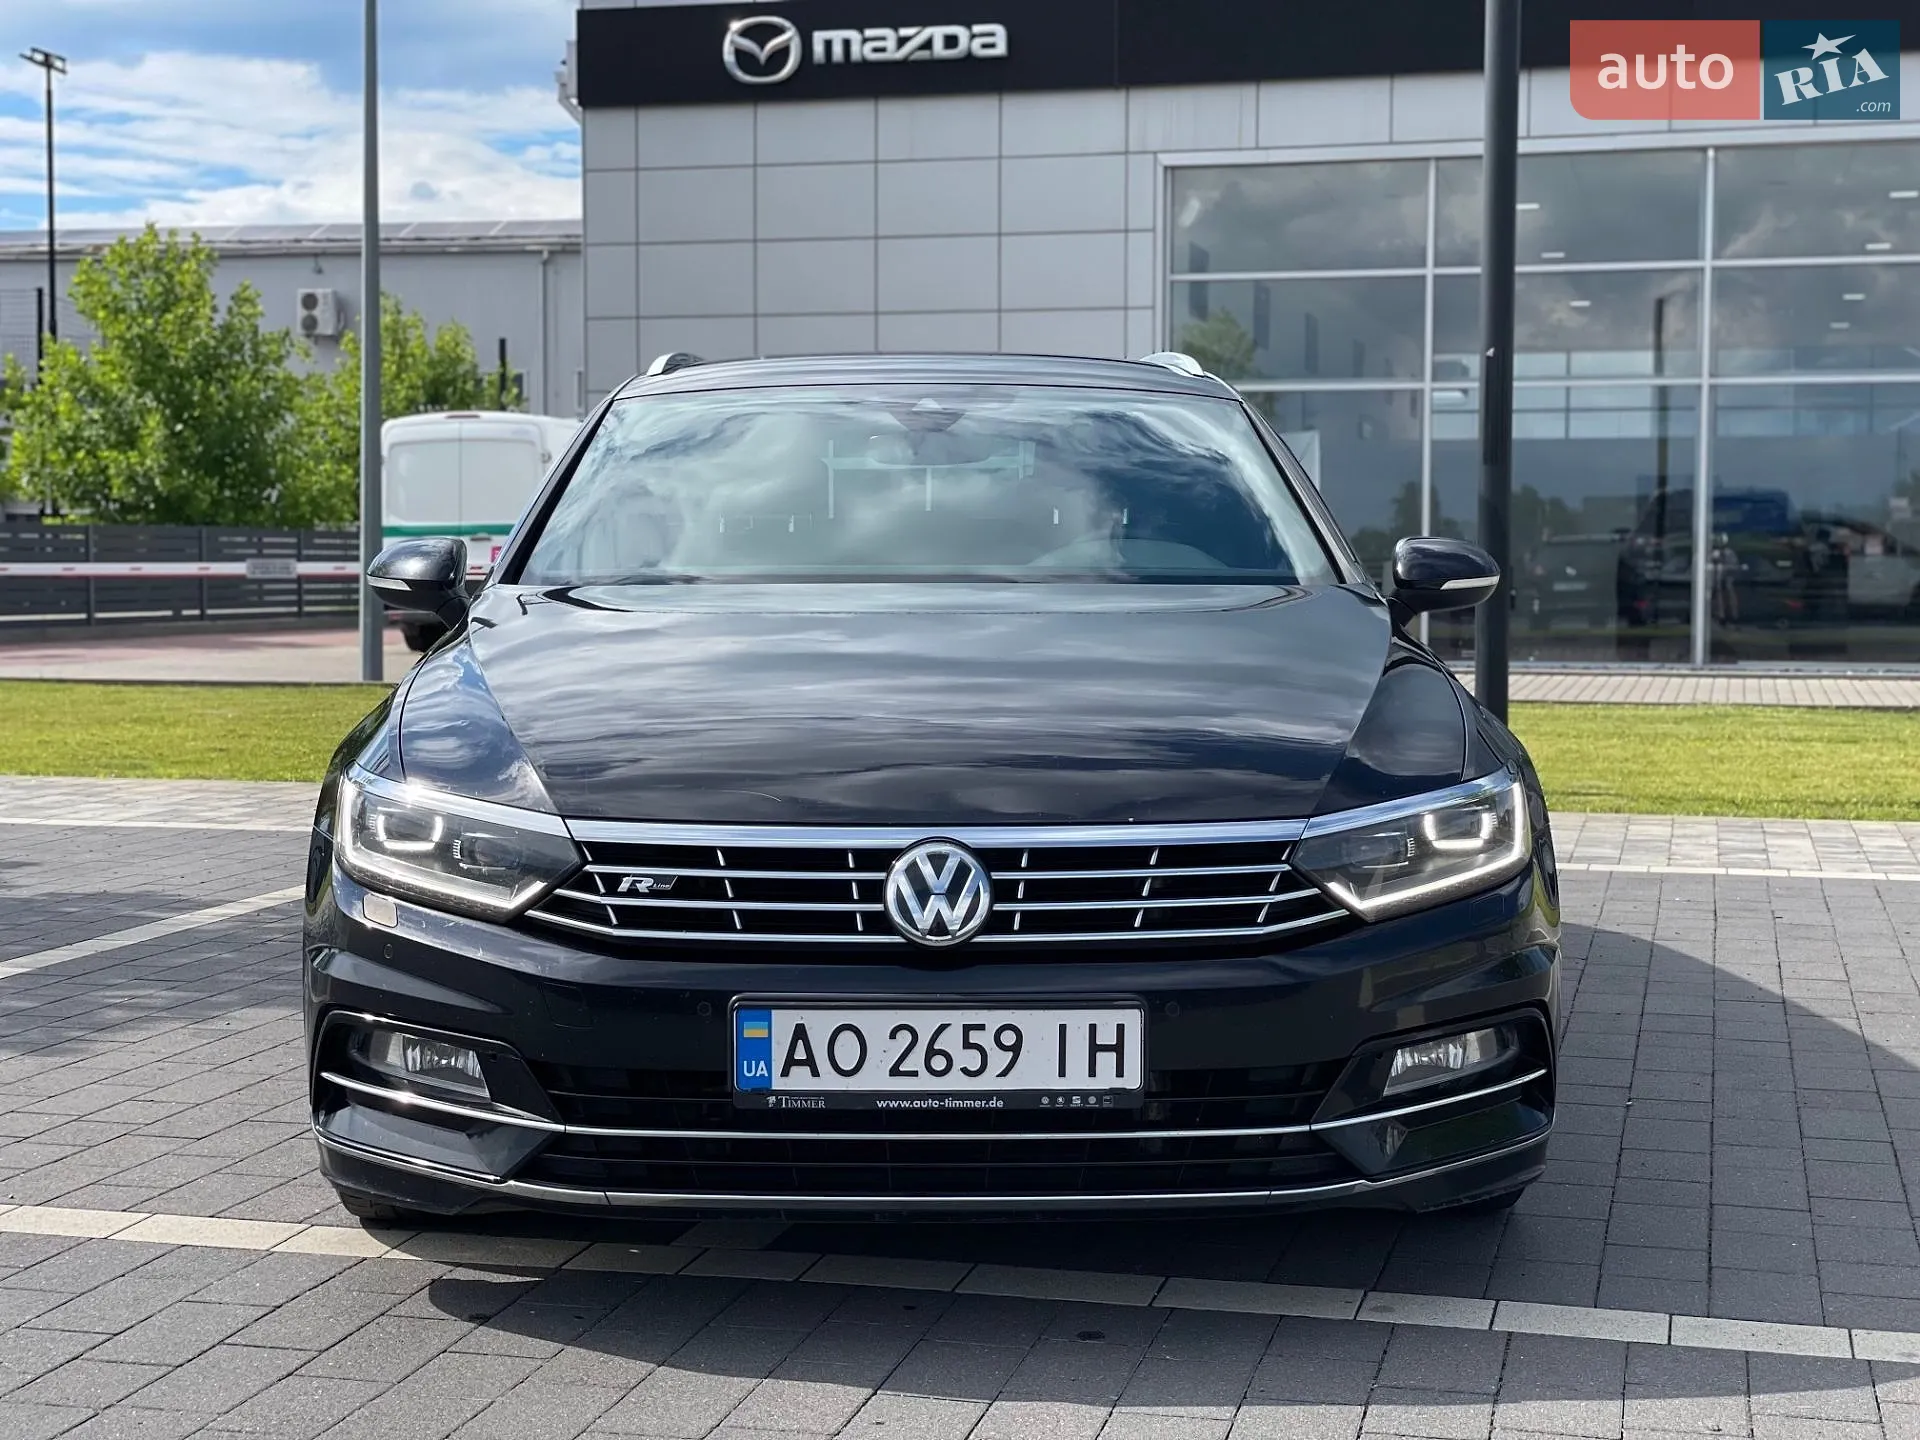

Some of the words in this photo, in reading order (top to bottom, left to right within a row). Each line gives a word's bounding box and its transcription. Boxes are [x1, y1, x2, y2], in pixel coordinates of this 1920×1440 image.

[779, 1022, 868, 1078] AO
[888, 1022, 1023, 1078] 2659
[1057, 1022, 1125, 1078] IH
[743, 1060, 769, 1077] UA
[876, 1097, 1004, 1108] www.auto-timmer.de
